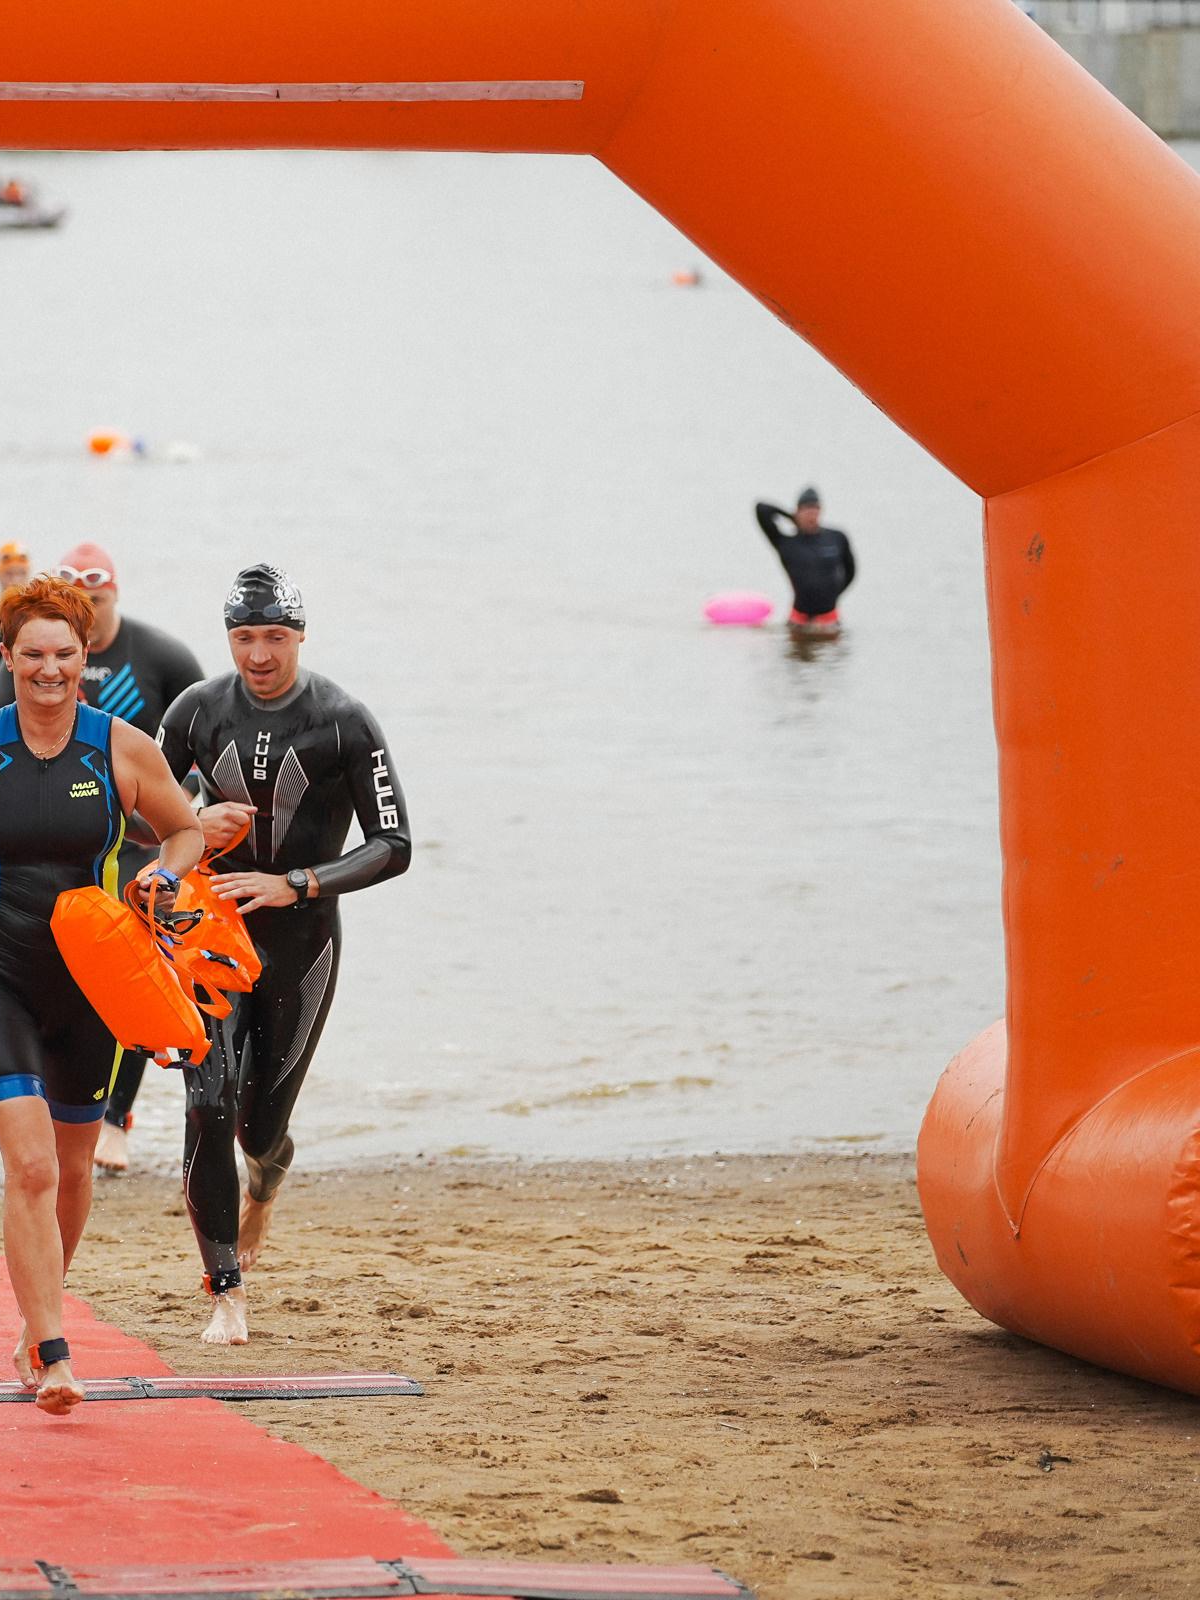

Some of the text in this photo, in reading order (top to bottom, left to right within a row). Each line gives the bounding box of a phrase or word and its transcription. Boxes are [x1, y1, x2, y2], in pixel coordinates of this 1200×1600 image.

[253, 731, 271, 780] HUUB
[69, 787, 100, 798] WAVE
[72, 780, 96, 791] MAD
[371, 749, 399, 830] HUUB
